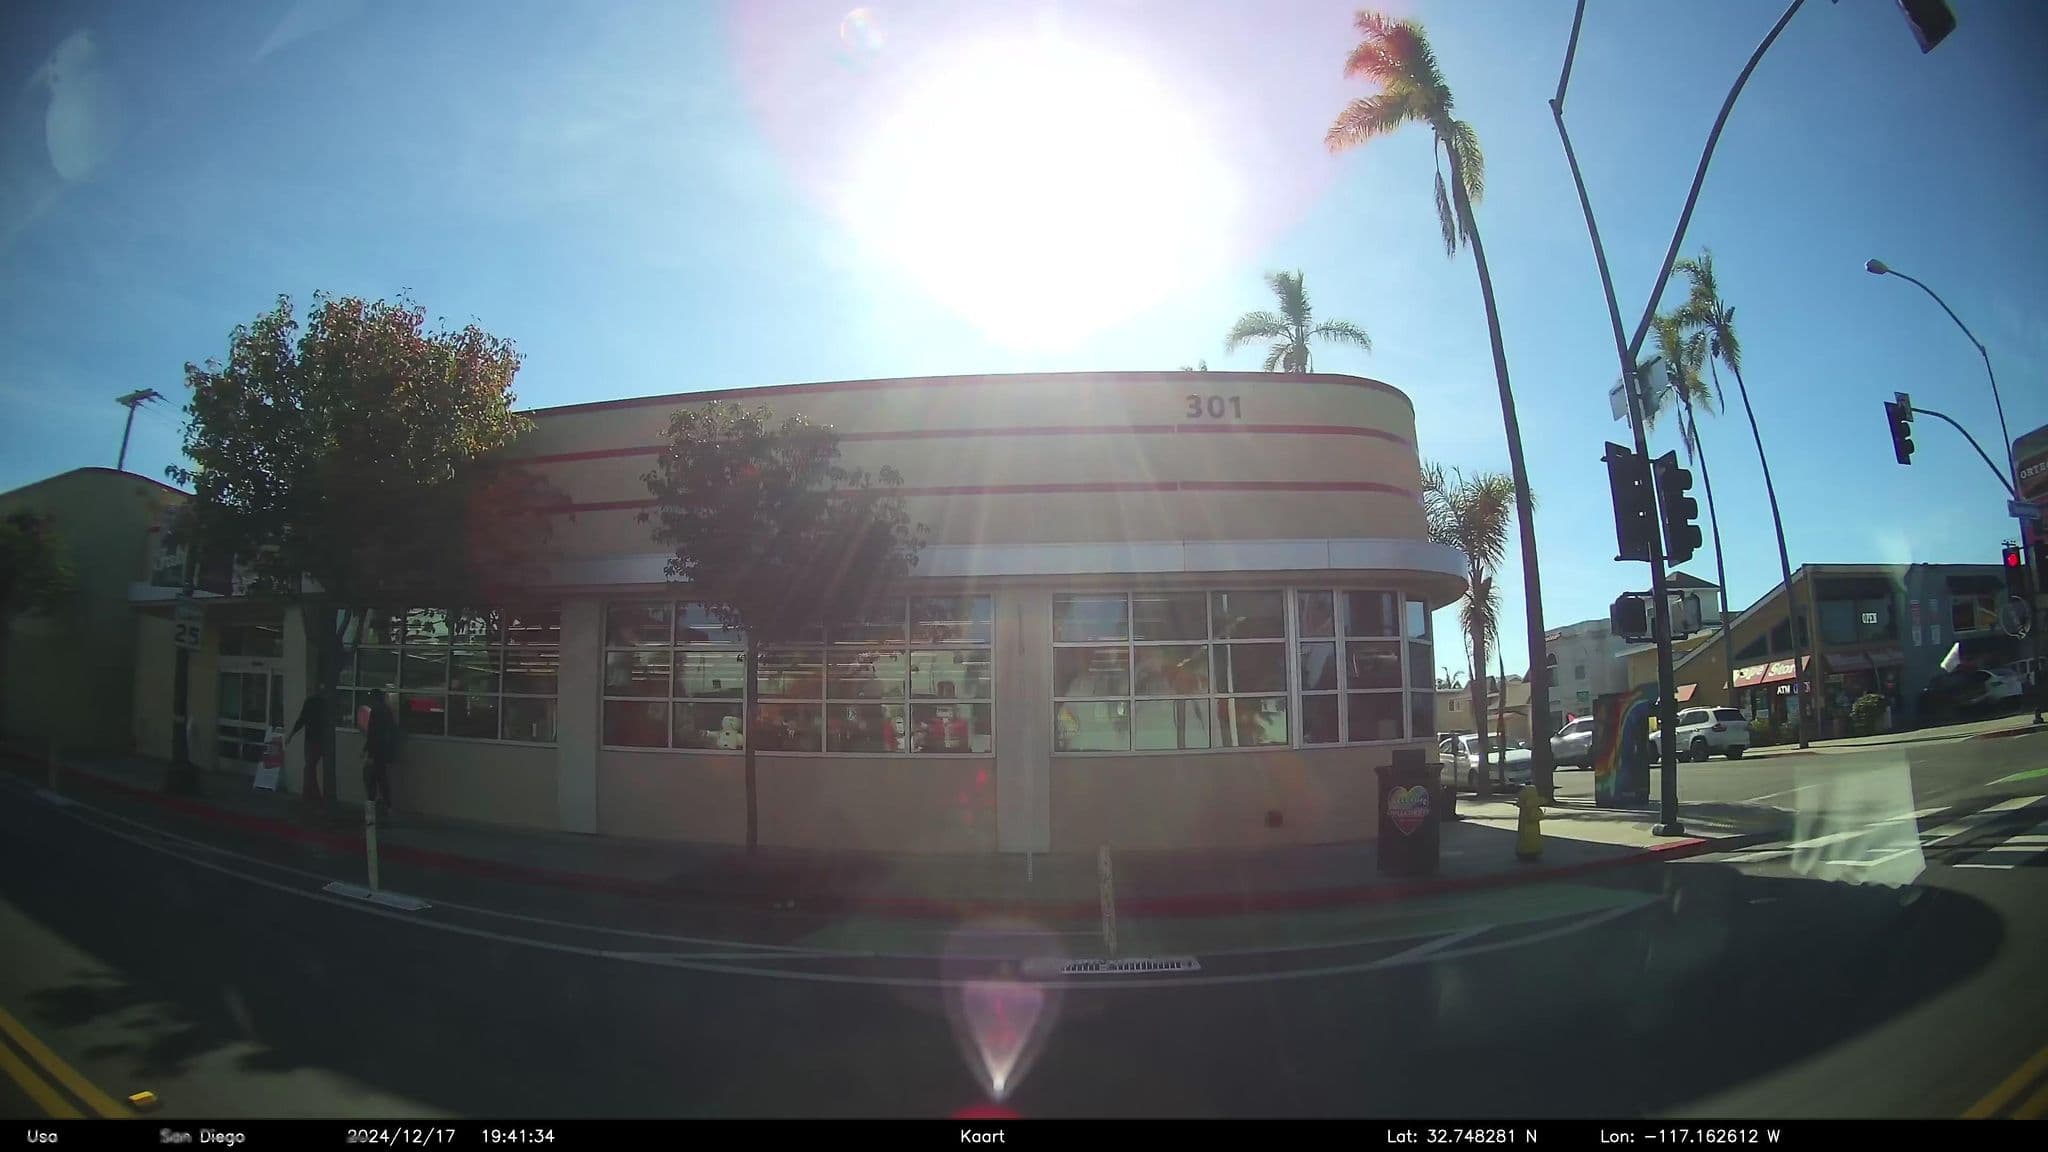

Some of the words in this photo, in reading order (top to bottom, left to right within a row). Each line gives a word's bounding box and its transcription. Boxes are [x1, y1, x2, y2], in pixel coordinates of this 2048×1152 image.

[1186, 395, 1241, 419] 301
[2020, 459, 2048, 479] ORTE
[175, 623, 200, 645] 25
[1777, 684, 1791, 695] ATM
